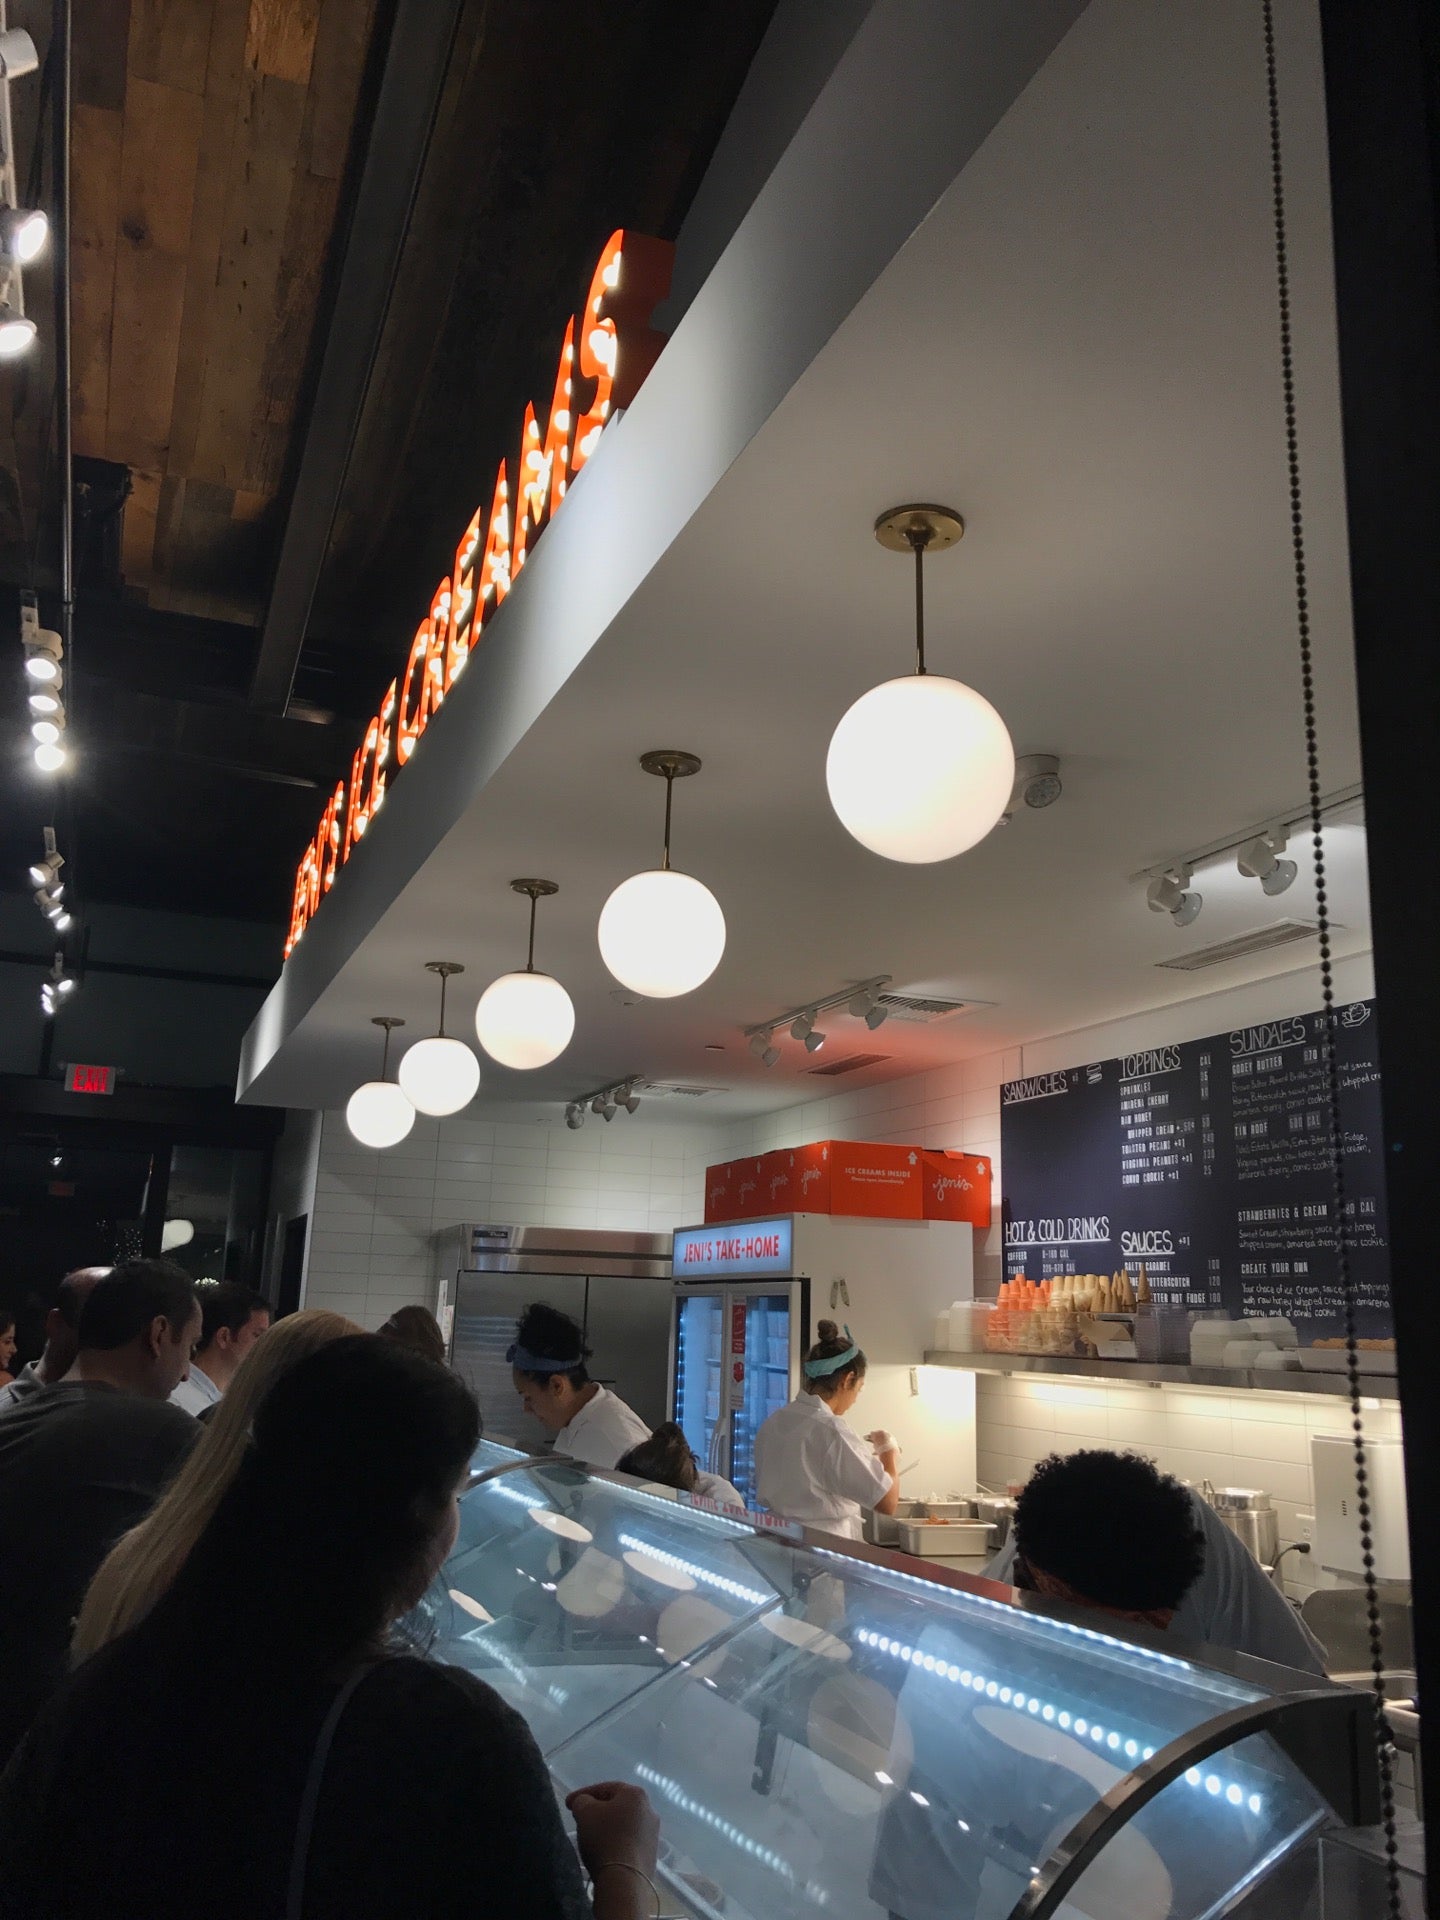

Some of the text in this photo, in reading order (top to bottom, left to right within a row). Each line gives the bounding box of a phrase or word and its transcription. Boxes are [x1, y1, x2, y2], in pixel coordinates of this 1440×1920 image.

[343, 677, 397, 865] ICE
[397, 229, 624, 767] CREAMS
[1230, 1017, 1306, 1054] SUNDAES
[1118, 1045, 1180, 1078] TOPPINGS
[1256, 1056, 1283, 1071] BUTTER
[1351, 1061, 1373, 1071] sauce
[73, 1064, 110, 1093] EXIT
[1342, 1073, 1370, 1089] whipped
[1003, 1071, 1067, 1102] SANDWICHES
[1120, 1082, 1151, 1096] SPRINKLES
[1147, 1094, 1169, 1106] CHERRY
[1134, 1111, 1152, 1123] HONEY
[1127, 1127, 1152, 1139] WHIPPED
[1155, 1124, 1175, 1135] CREAM
[1234, 1125, 1247, 1136] TIN
[1307, 1114, 1321, 1127] CAL
[1122, 1143, 1146, 1154] TOASTED
[1149, 1140, 1170, 1151] PECANS
[1122, 1158, 1150, 1170] VIRGINIA
[1153, 1154, 1179, 1166] PEANUTS
[845, 1167, 911, 1178] ICE CREAMS INSIDE
[1143, 1171, 1164, 1183] COOKIE
[1238, 1207, 1290, 1222] STRAWBERRIES
[1294, 1206, 1299, 1218] &
[1303, 1204, 1328, 1217] CREAM
[1360, 1201, 1376, 1214] CAL
[1005, 1216, 1110, 1242] HOT & COLD DRINKS
[1355, 1222, 1377, 1237] honey
[1121, 1230, 1173, 1253] SAUCES
[684, 1235, 780, 1264] JENI'S TAKE-HOME
[1124, 1261, 1141, 1271] SALTY
[1145, 1261, 1170, 1271] CARAMEL
[1241, 1261, 1309, 1274] CREATE YOUR OWN
[1147, 1276, 1190, 1287] UTTERSCOTCH
[1208, 1275, 1220, 1287] 120
[1170, 1292, 1183, 1303] HOT
[1186, 1292, 1206, 1303] FUDGE
[1257, 1296, 1271, 1304] raw
[1272, 1295, 1292, 1312] honey
[1294, 1296, 1323, 1311] whipped
[1356, 1297, 1391, 1309] amarena
[1269, 1307, 1282, 1317] and
